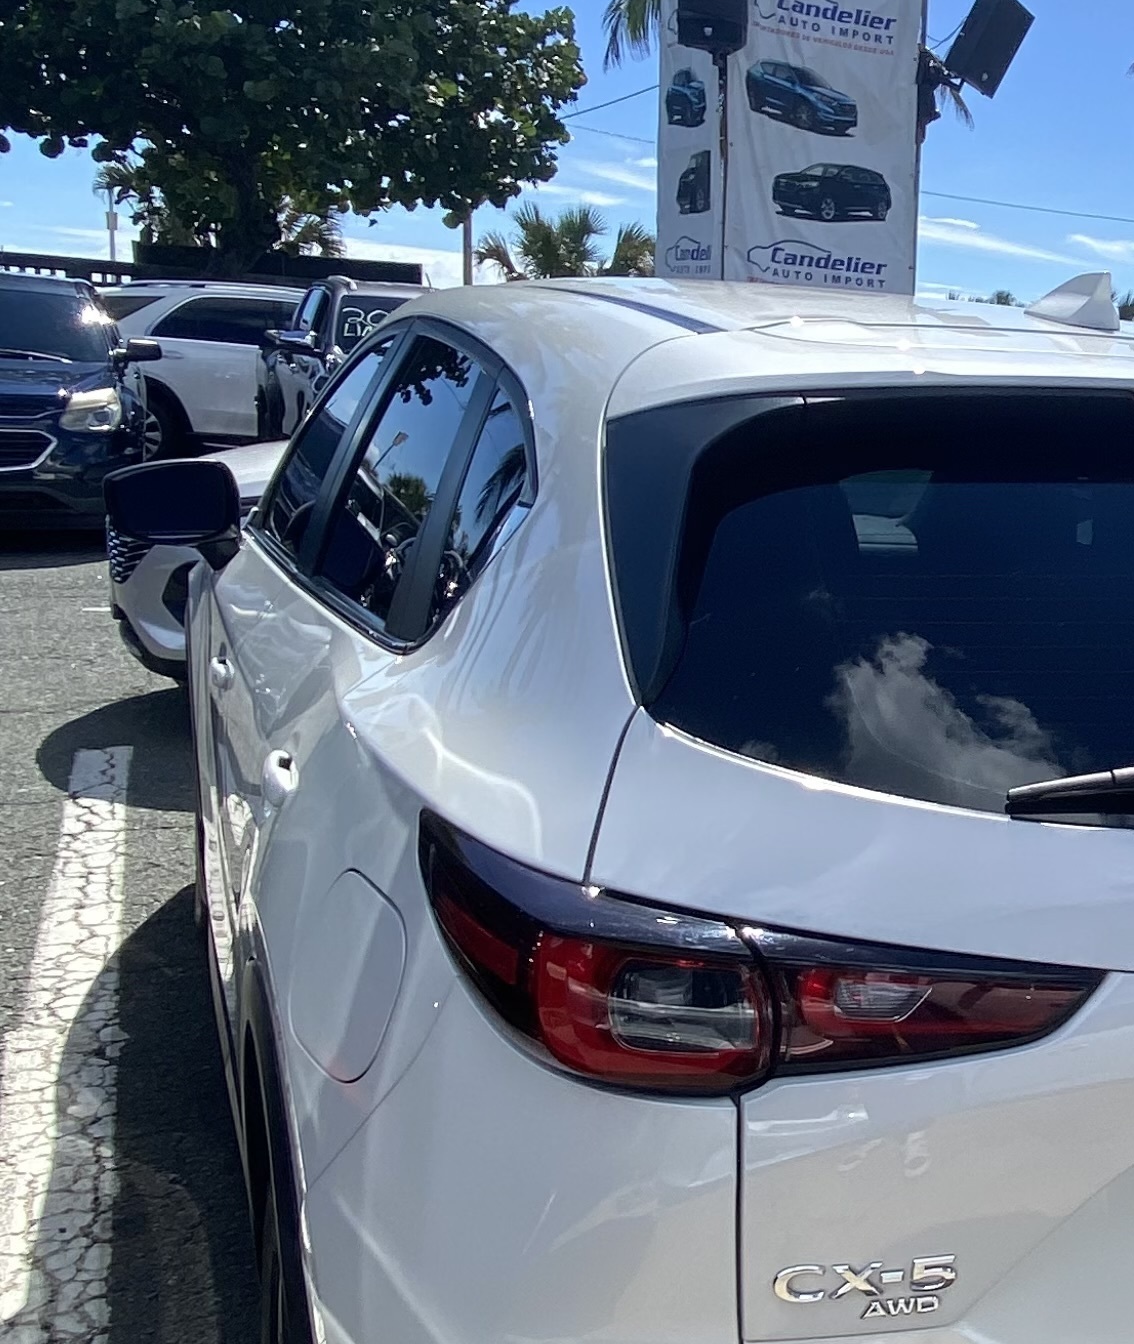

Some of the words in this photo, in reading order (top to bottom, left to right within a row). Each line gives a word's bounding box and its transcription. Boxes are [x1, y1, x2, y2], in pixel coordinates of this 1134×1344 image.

[778, 15, 821, 32] AUTO
[831, 25, 894, 45] IMPORT
[770, 247, 888, 275] Candelier
[772, 267, 813, 281] AUTO
[823, 273, 886, 289] IMPORT
[773, 1254, 956, 1304] CX-5
[860, 1294, 940, 1320] AWD
